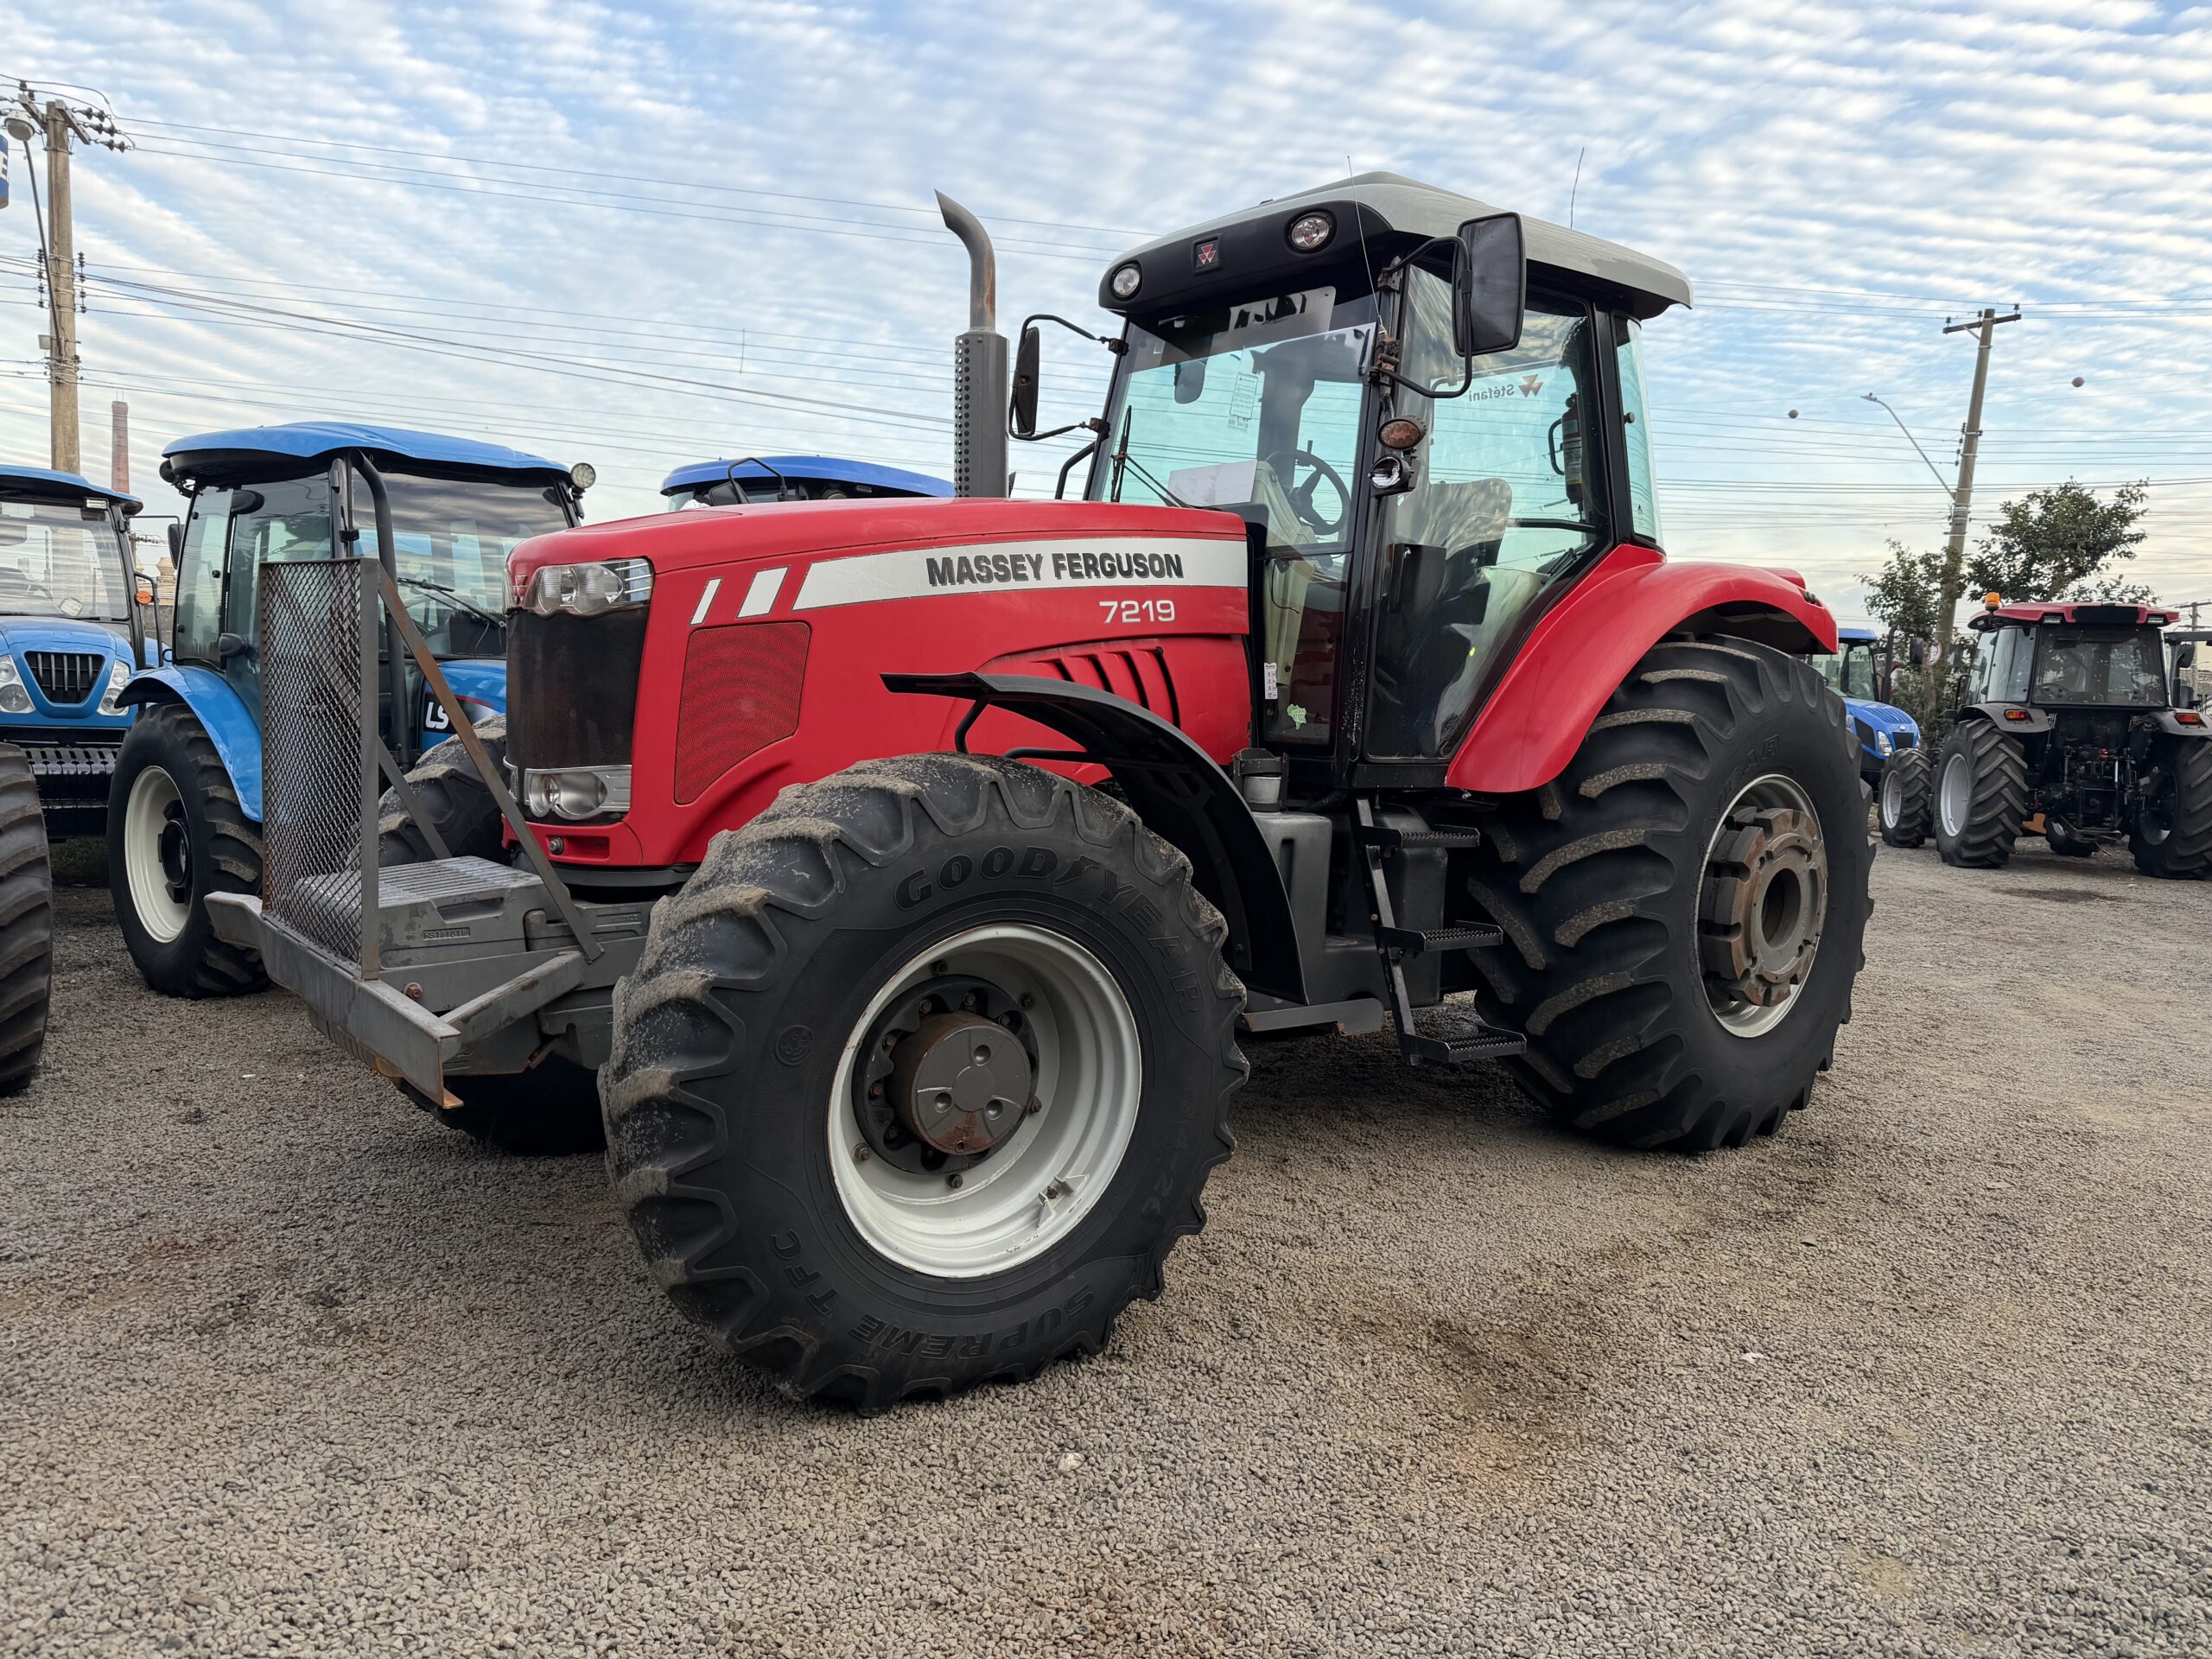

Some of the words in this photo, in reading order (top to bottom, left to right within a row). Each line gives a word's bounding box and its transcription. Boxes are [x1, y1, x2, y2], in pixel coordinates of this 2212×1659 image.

[926, 552, 1044, 588] MASSEY
[1052, 551, 1184, 581] FERGUSON
[1098, 600, 1176, 624] 7219
[425, 701, 449, 730] LS
[894, 845, 1204, 1014] GOODYEAR
[769, 1229, 840, 1316] TFC
[849, 1281, 1095, 1360] SUPREME
